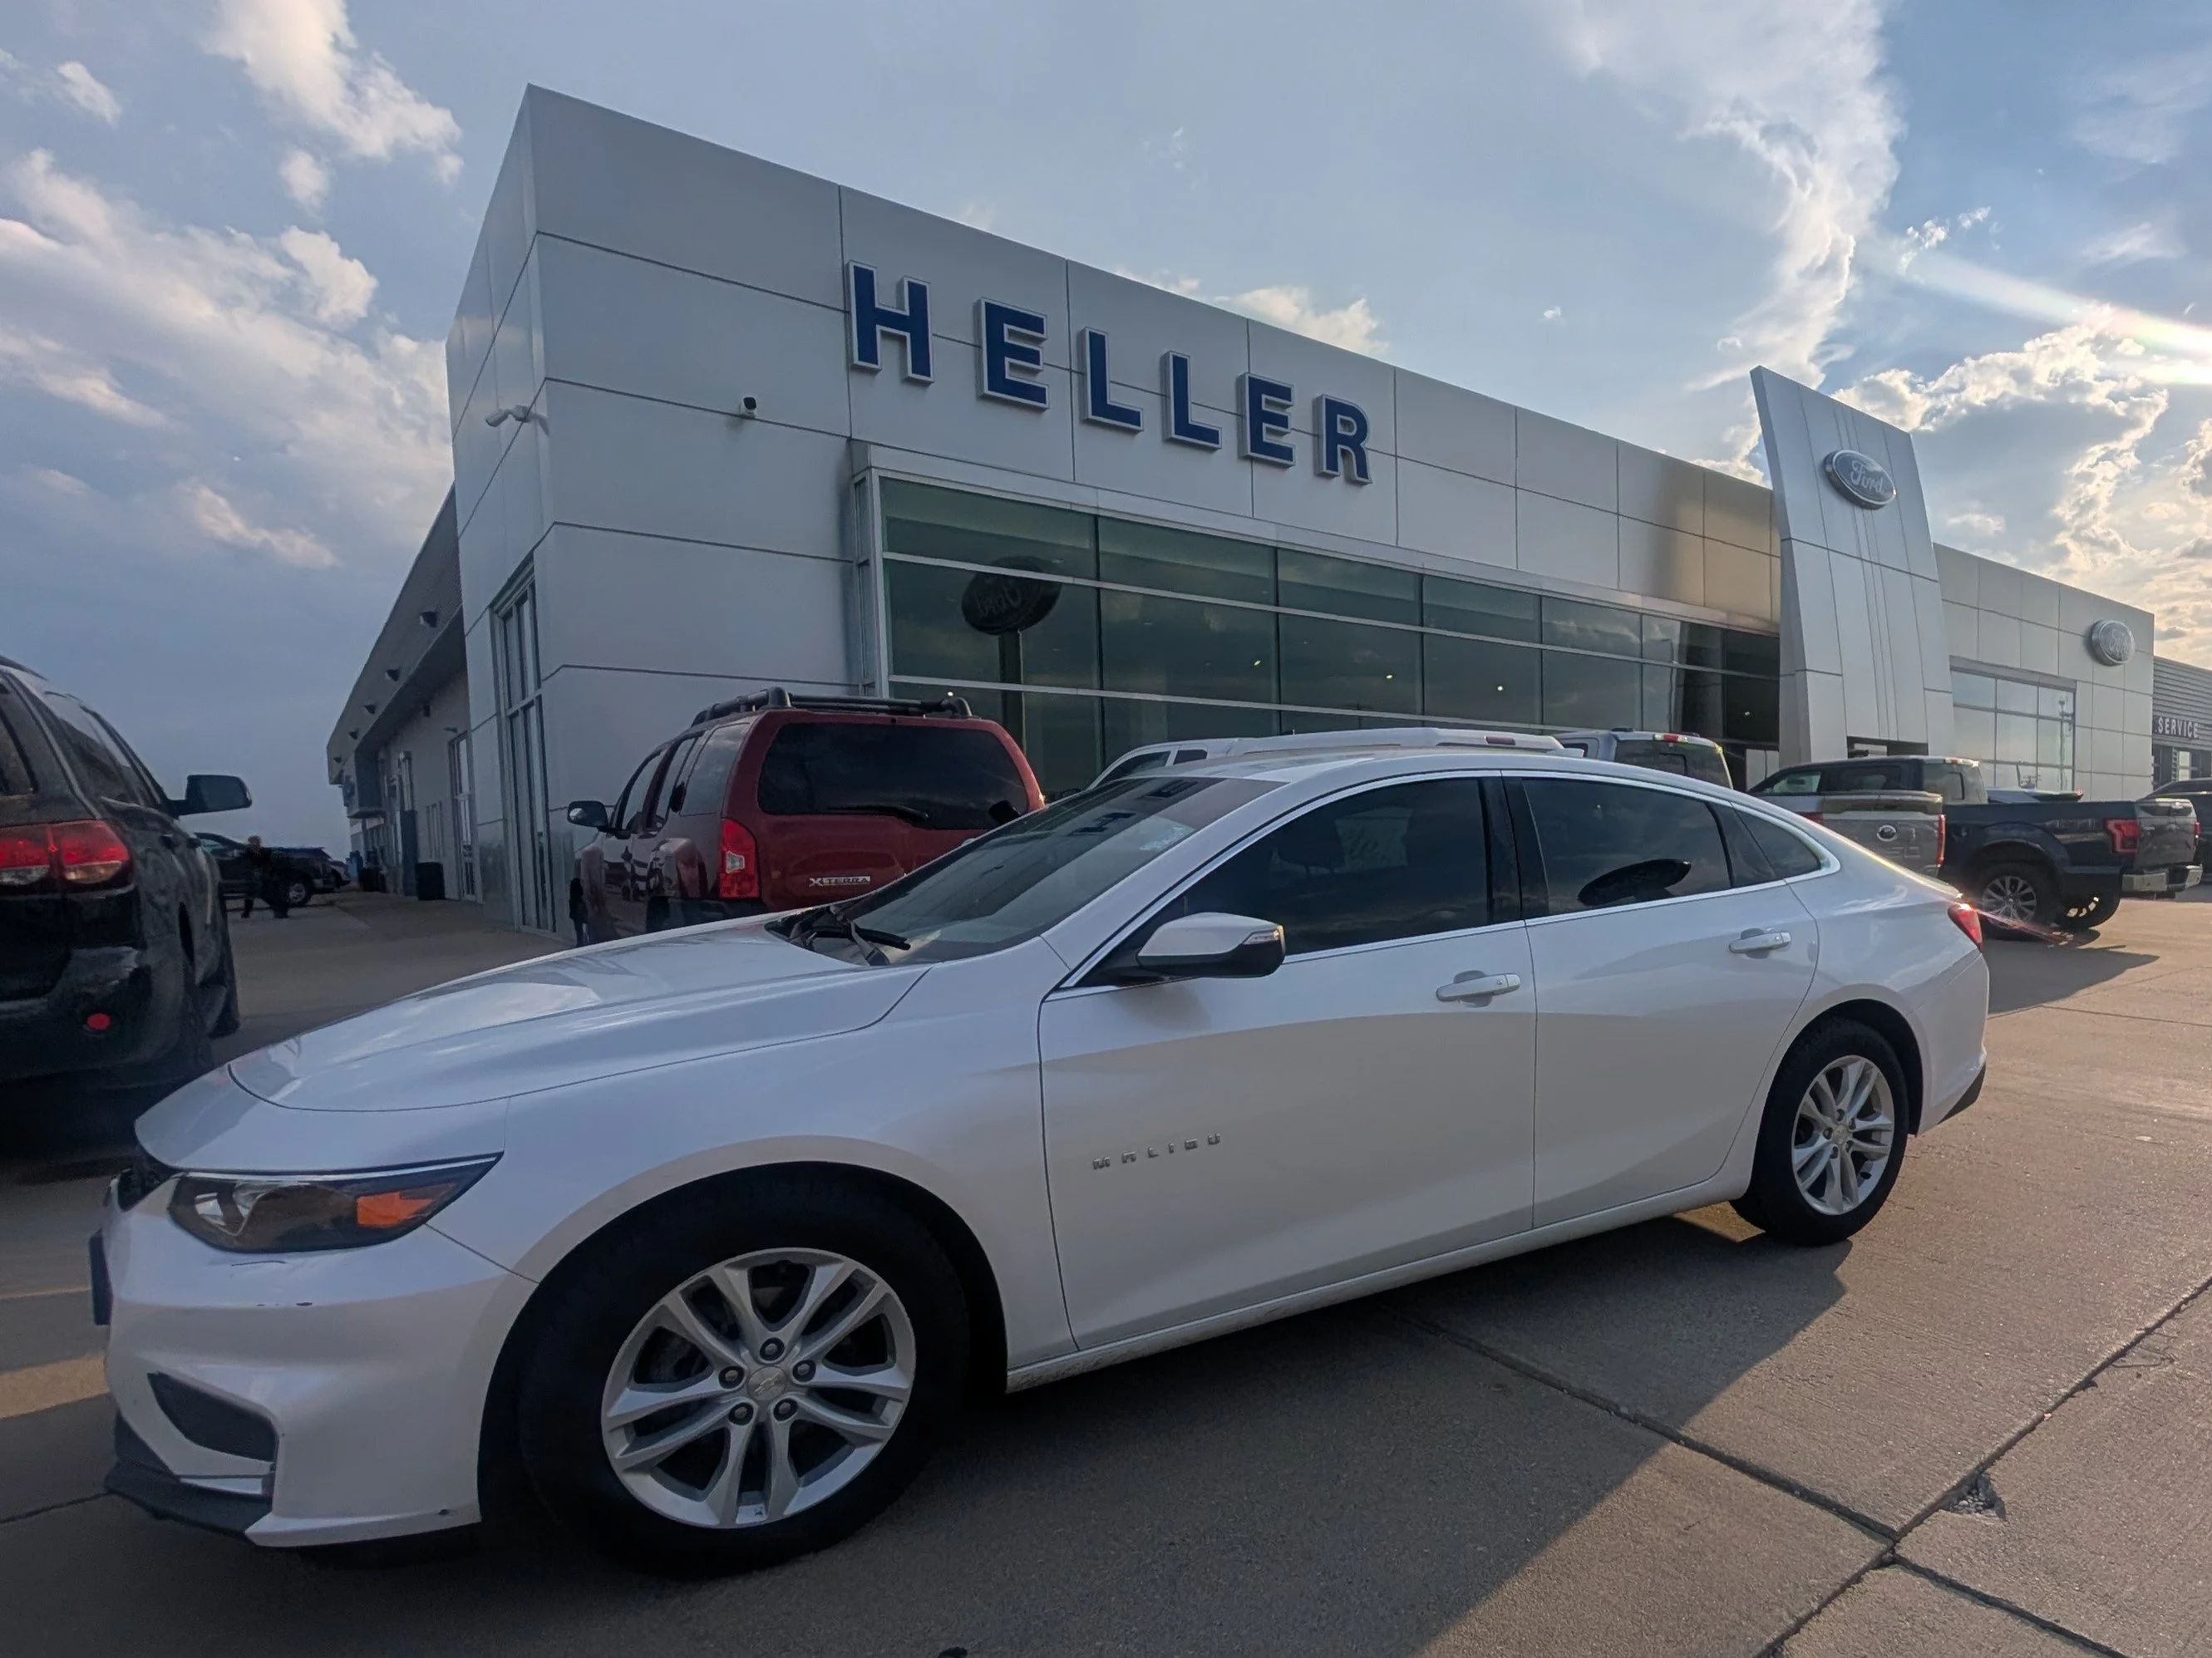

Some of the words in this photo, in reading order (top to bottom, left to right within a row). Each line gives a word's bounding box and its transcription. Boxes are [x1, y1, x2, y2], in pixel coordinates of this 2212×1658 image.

[846, 259, 1372, 485] HELLER
[1850, 460, 1883, 494] Ford
[2158, 716, 2199, 738] SERVICE
[808, 876, 870, 888] XTERRA
[1092, 1133, 1220, 1170] MALIBU
